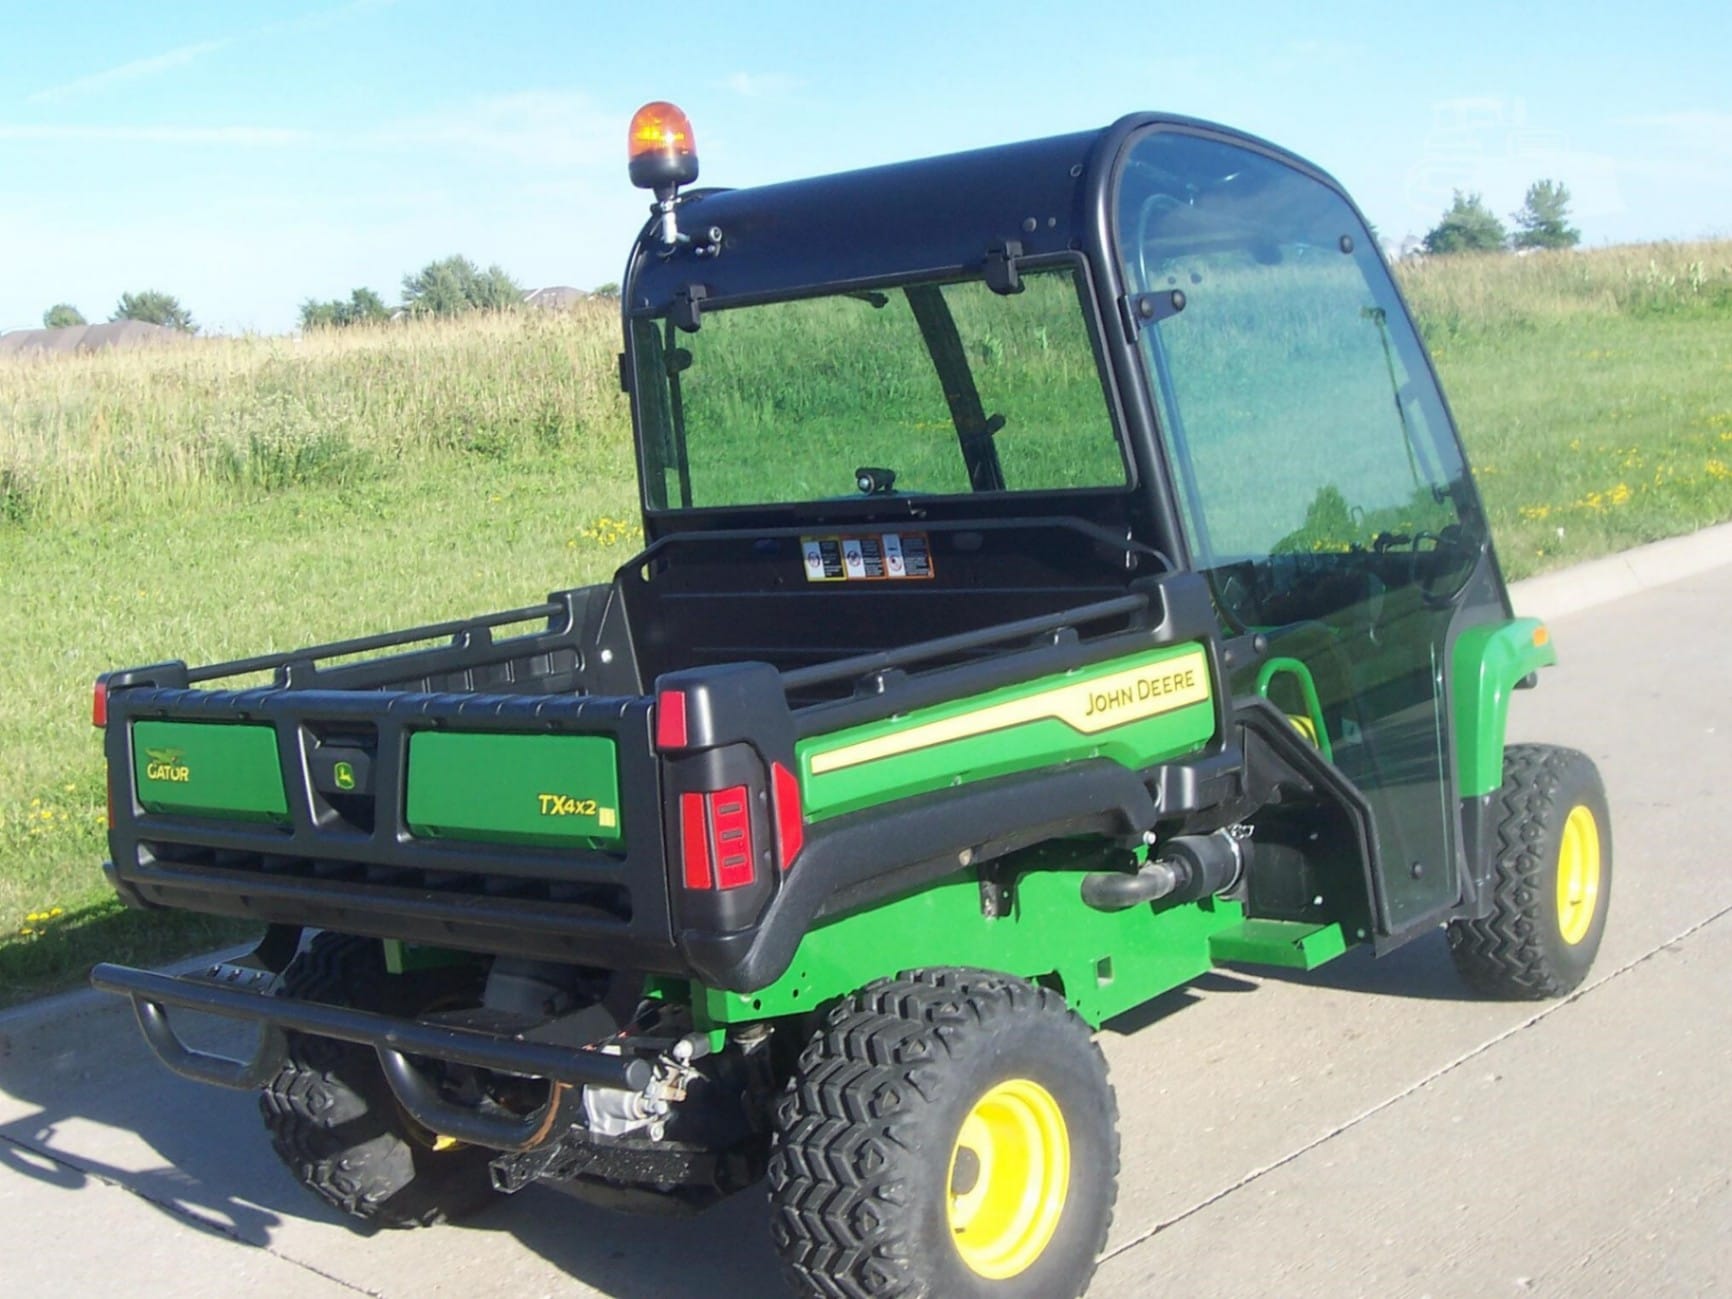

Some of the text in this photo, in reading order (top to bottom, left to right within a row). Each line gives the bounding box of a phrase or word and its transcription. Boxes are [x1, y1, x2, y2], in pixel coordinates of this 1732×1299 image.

[1085, 669, 1196, 716] JOHN DEERE
[146, 762, 190, 782] GATOR
